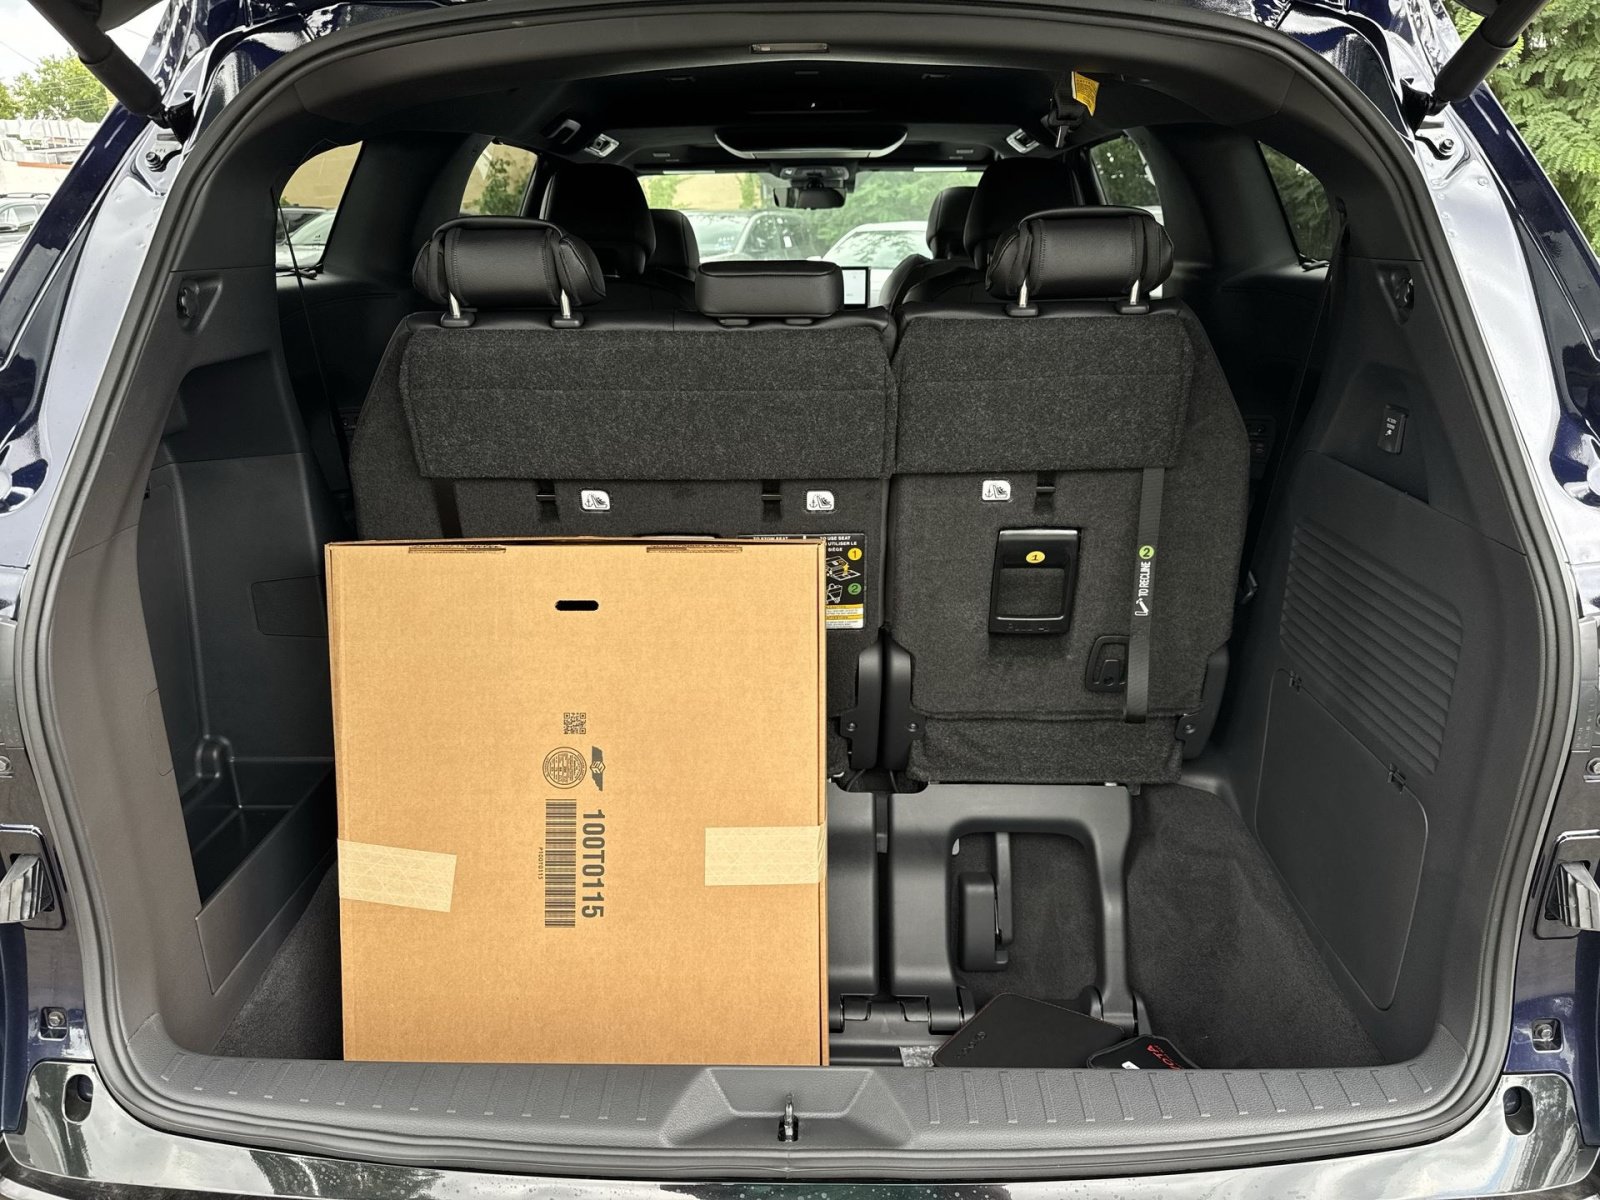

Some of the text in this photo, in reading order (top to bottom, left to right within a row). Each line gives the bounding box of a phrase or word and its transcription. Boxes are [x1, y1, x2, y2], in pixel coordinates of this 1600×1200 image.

[1138, 561, 1151, 597] TO RECLINE
[581, 809, 606, 919] 100T0115
